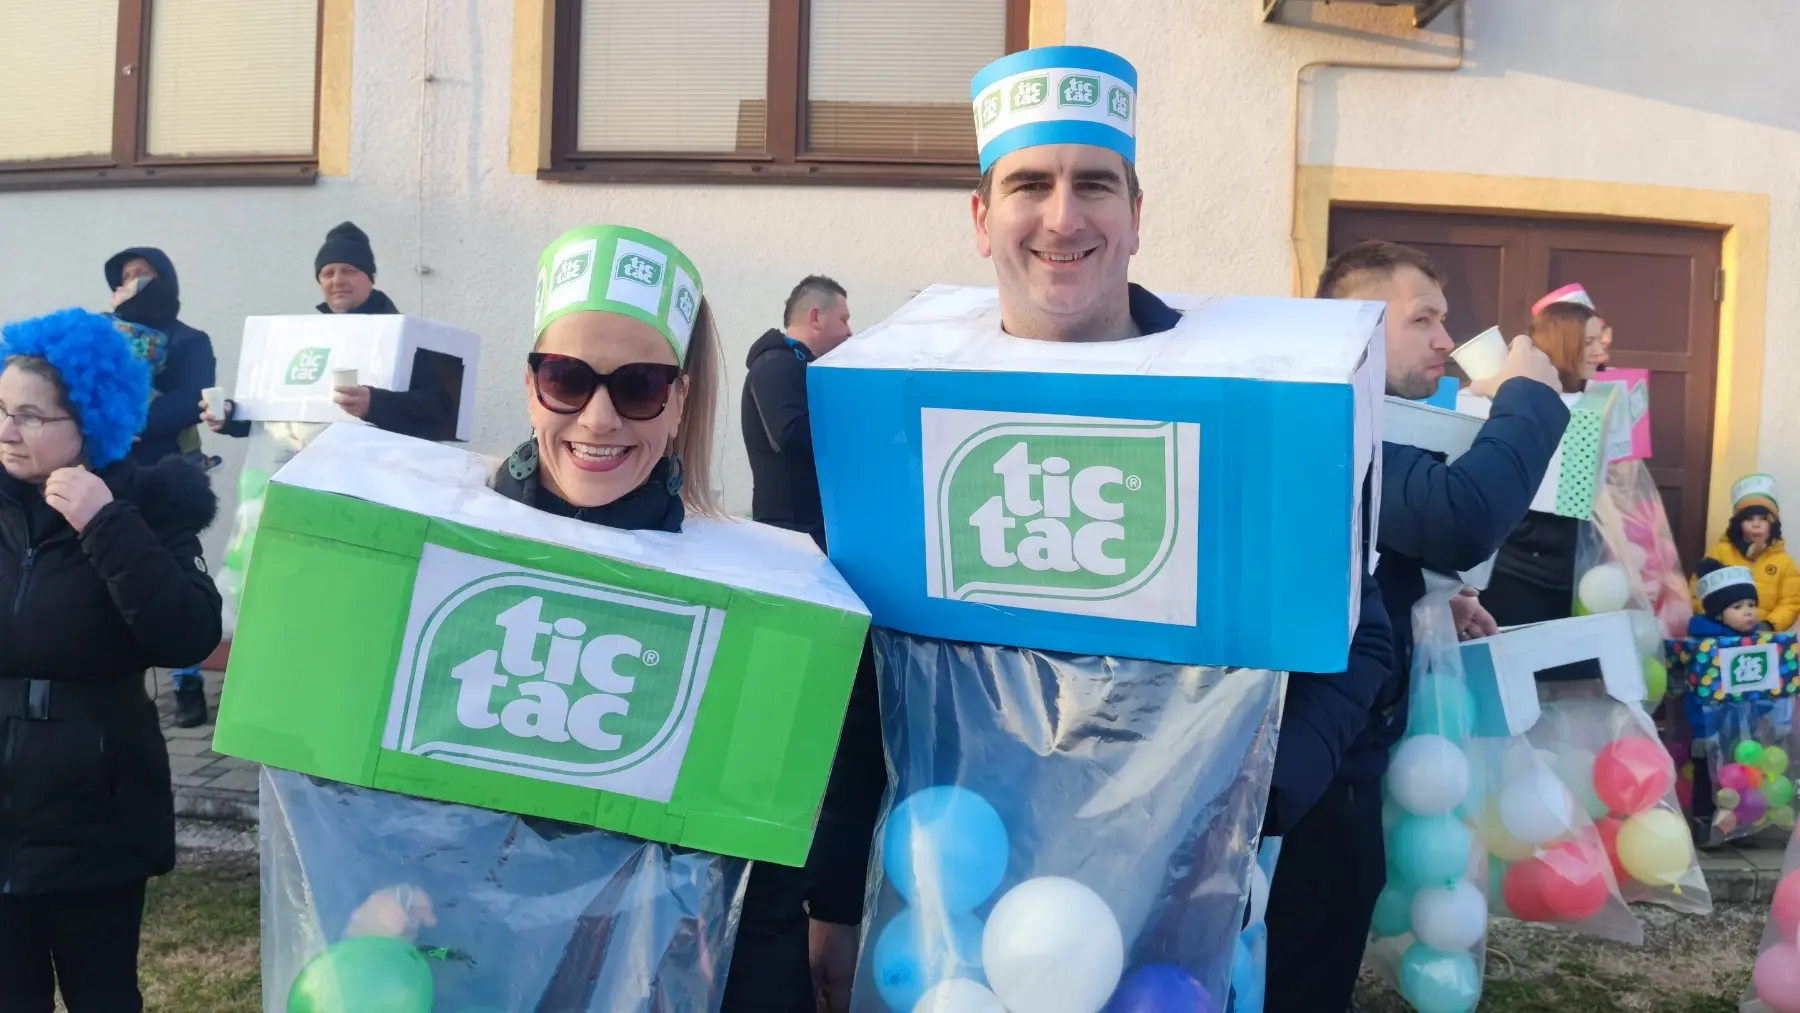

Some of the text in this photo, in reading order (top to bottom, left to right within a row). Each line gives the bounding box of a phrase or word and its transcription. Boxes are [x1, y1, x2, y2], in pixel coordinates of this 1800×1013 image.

[1016, 80, 1042, 94] tic
[1069, 77, 1093, 93] tic
[1014, 91, 1041, 107] tac
[1063, 87, 1093, 103] tac
[624, 264, 653, 284] tac
[630, 256, 654, 275] tic
[299, 350, 323, 368] tic
[291, 366, 319, 380] tac
[969, 495, 1126, 576] tac
[450, 649, 630, 751] tac
